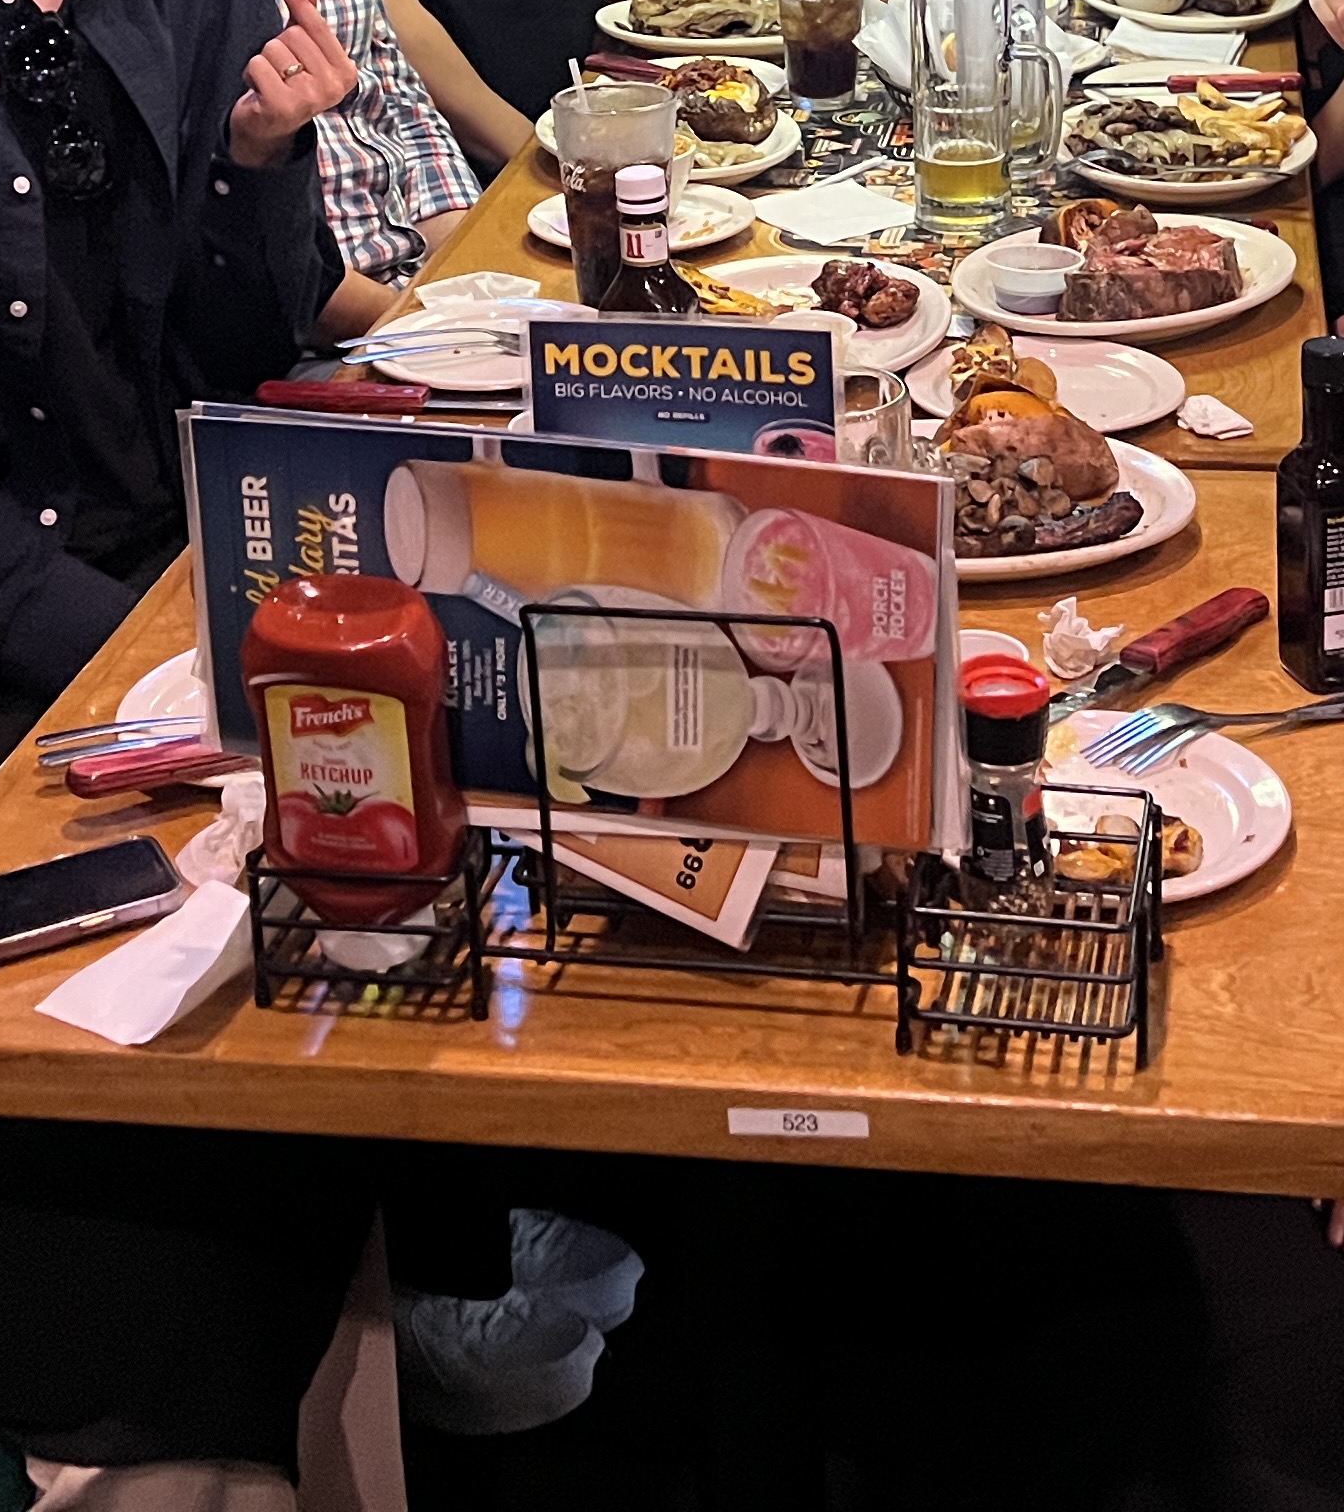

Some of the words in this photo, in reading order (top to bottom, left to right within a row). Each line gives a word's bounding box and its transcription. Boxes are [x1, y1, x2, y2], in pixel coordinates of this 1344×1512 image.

[544, 342, 816, 386] MOCKTAILS
[555, 383, 585, 399] BIG
[589, 383, 674, 401] FLAVORS
[688, 387, 717, 403] NO
[721, 389, 808, 408] ALCOHOL
[241, 475, 273, 561] BEER
[328, 492, 360, 575] RITAS
[872, 577, 888, 638] PORCH
[889, 569, 906, 640] ROCKER
[293, 704, 365, 728] French's
[300, 762, 374, 785] KETCHUP
[782, 1113, 819, 1132] 523
